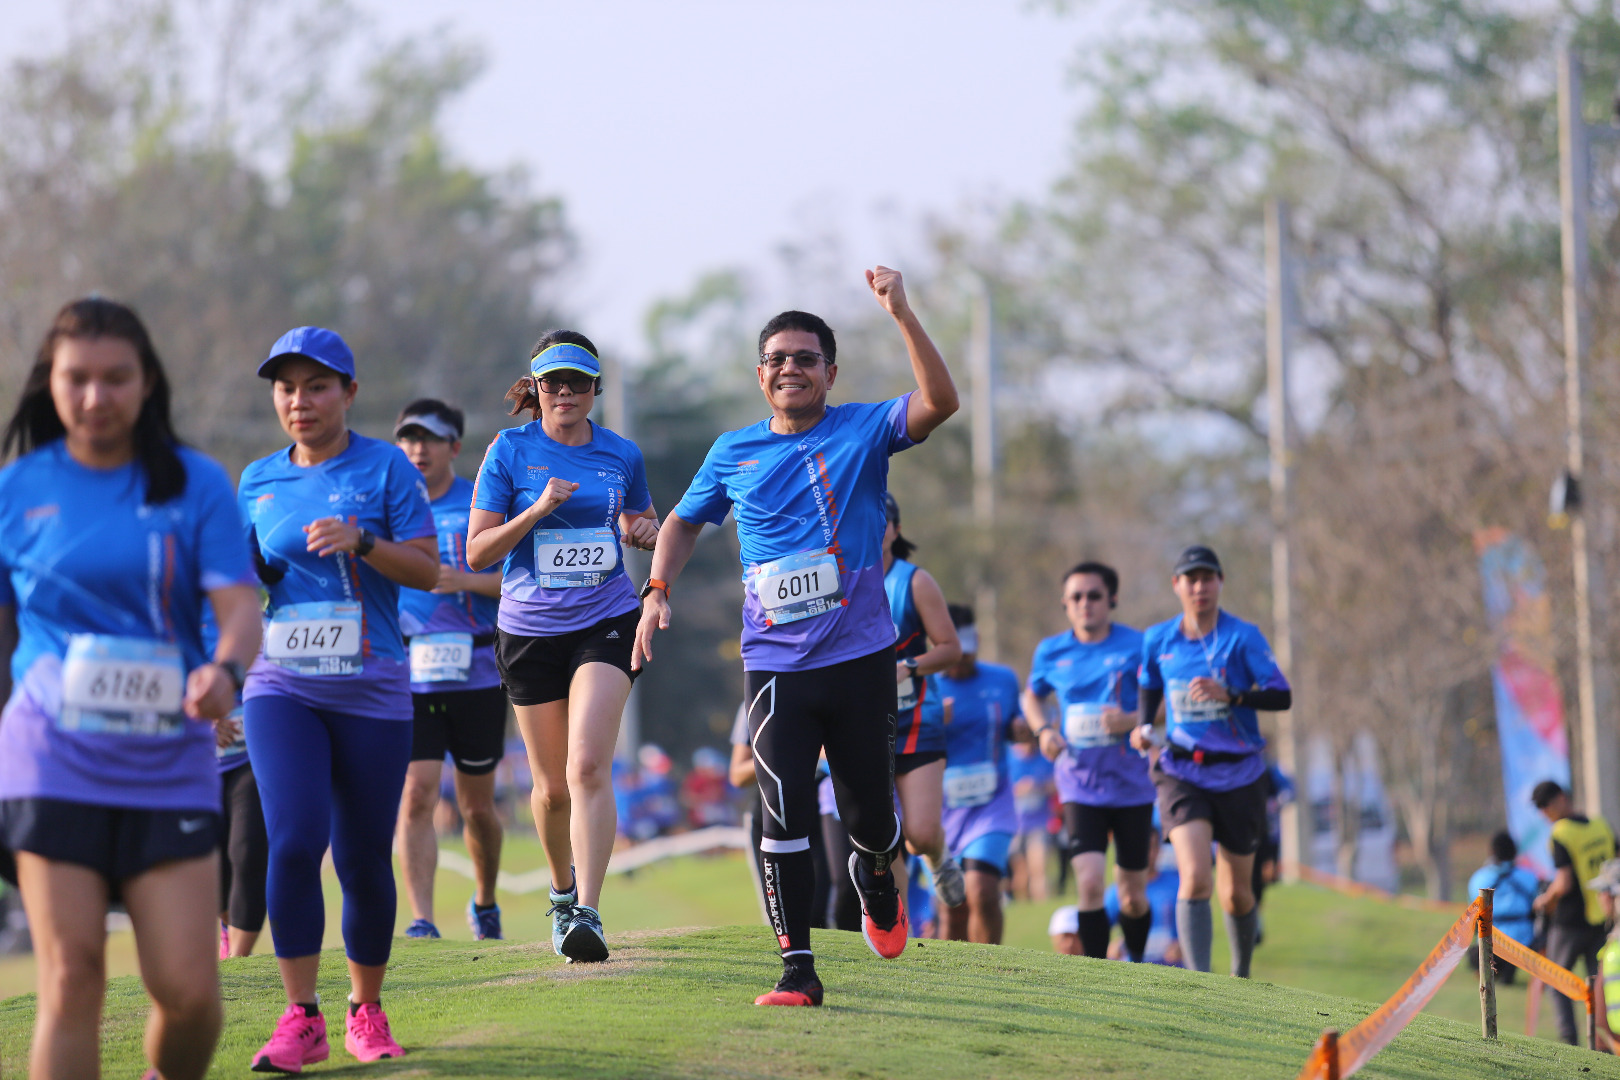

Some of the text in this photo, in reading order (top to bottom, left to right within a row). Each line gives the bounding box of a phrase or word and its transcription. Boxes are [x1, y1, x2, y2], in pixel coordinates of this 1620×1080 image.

[798, 444, 807, 452] SP
[804, 456, 817, 485] CROSS
[812, 485, 829, 528] COUNTRY
[815, 452, 832, 490] SINGHA
[825, 490, 839, 518] PARK
[836, 557, 847, 575] RAI
[553, 546, 604, 567] 6232
[778, 571, 819, 600] 6011
[826, 598, 836, 610] 16
[286, 626, 343, 650] 6147
[422, 647, 462, 665] 6220
[89, 669, 163, 702] 6186
